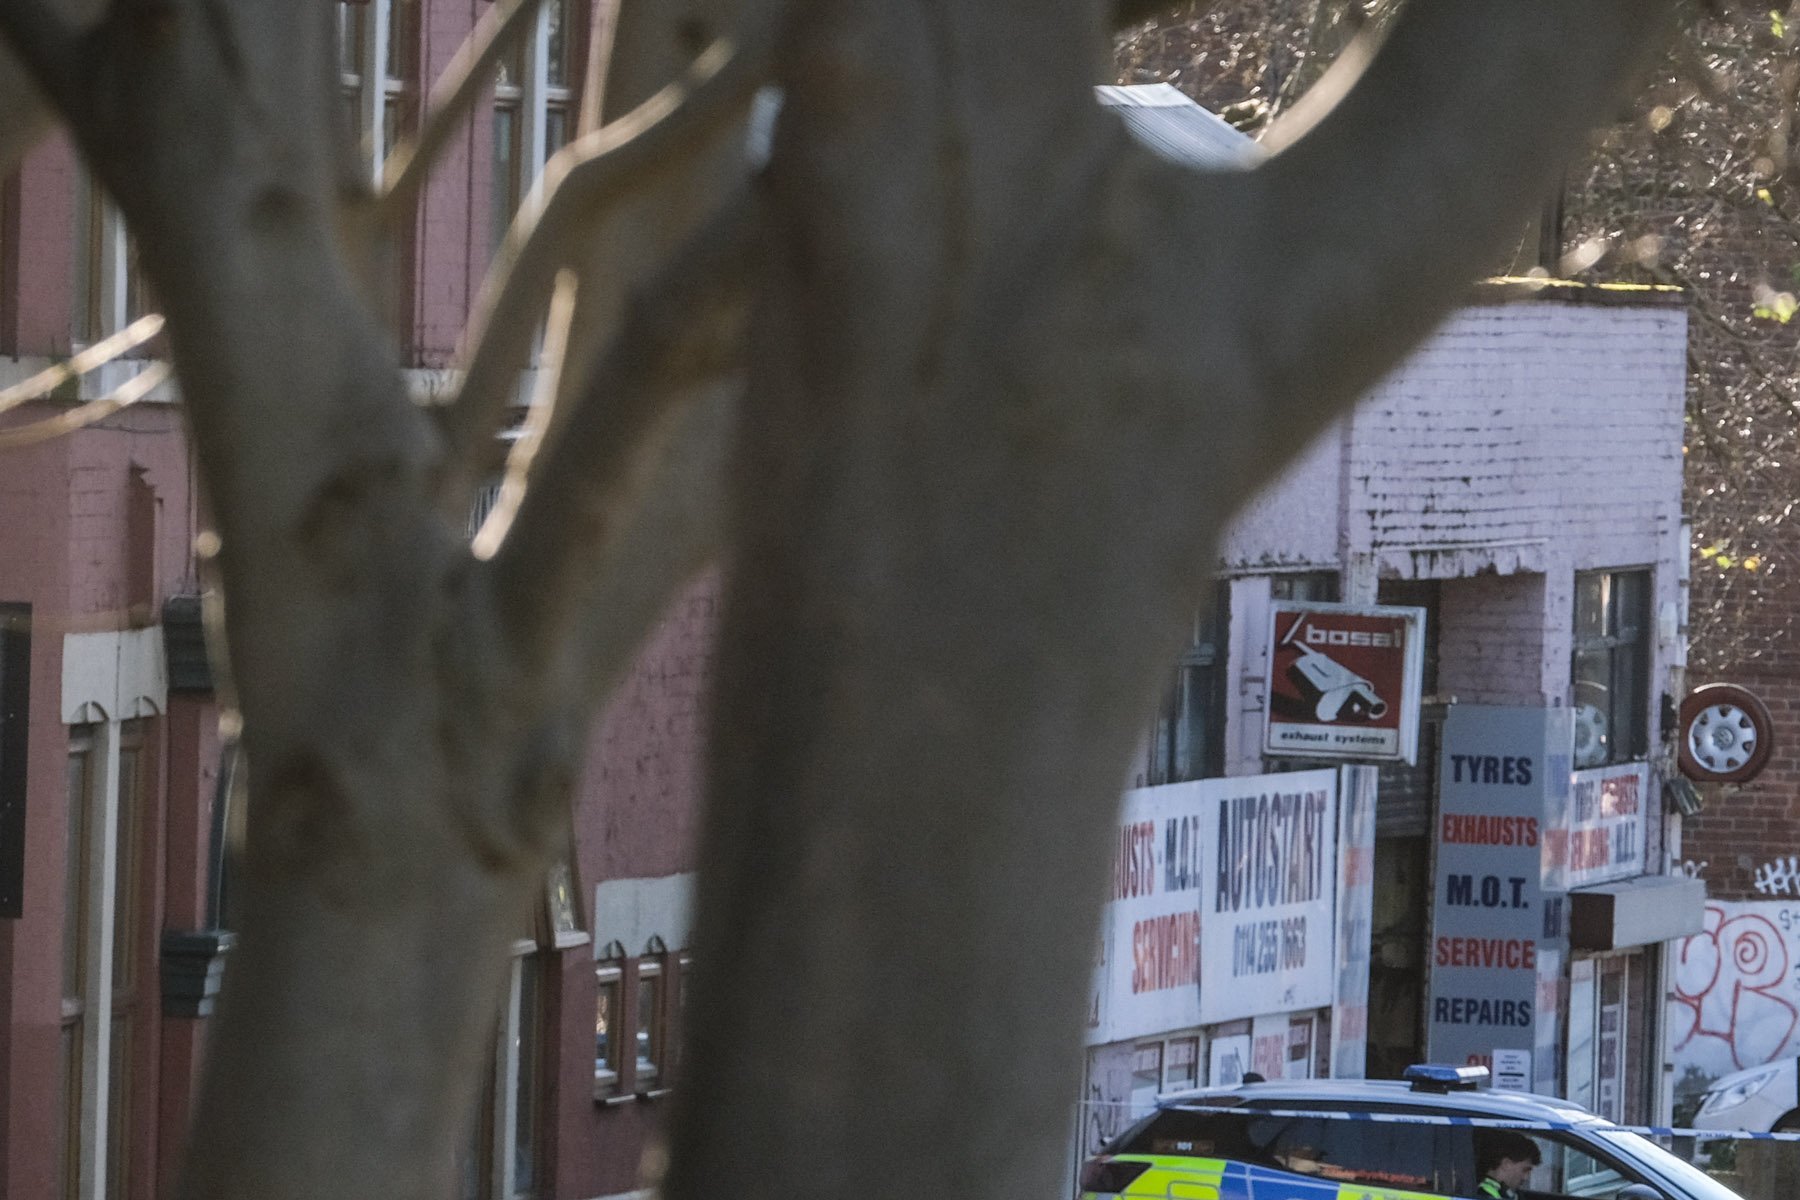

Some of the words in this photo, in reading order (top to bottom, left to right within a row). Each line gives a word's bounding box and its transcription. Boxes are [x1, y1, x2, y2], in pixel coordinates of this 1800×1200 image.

[1305, 623, 1400, 648] bosal
[1281, 731, 1329, 742] exhaust
[1334, 733, 1386, 744] systems
[1451, 754, 1533, 785] TYRES
[1443, 813, 1538, 847] EXHAUSTS
[1113, 820, 1155, 900] AUSTS
[1215, 790, 1327, 913] AUTOSTART
[1447, 874, 1529, 908] M.O.T.
[1436, 937, 1536, 969] SERVICE
[1435, 997, 1531, 1027] REPAIRS
